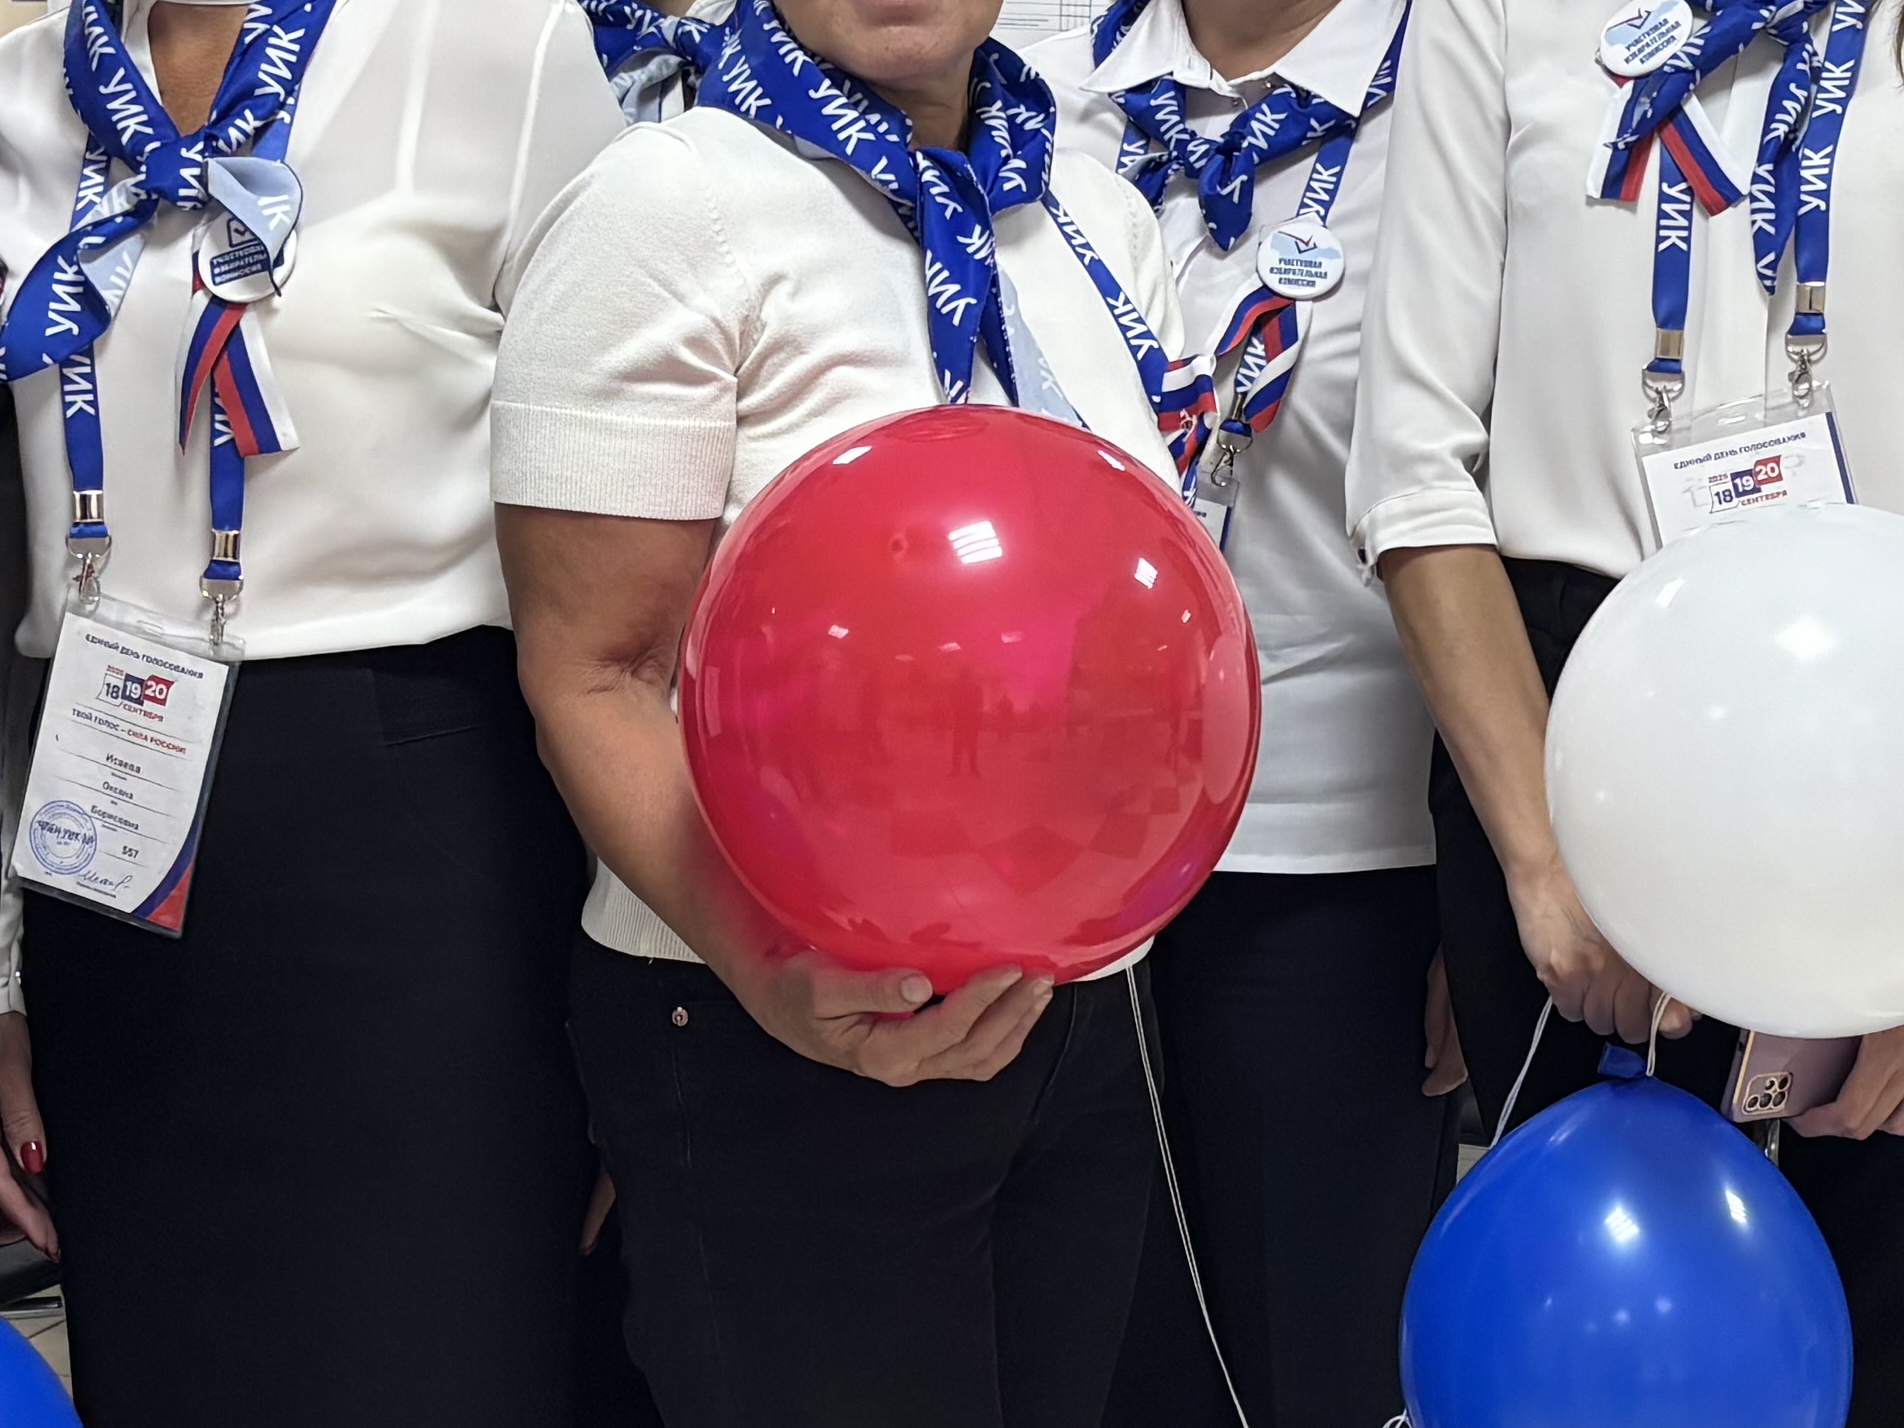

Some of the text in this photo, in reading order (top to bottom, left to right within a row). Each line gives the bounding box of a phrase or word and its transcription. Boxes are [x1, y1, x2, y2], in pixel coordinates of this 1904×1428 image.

[254, 24, 306, 102] УИК
[722, 55, 772, 119] УИК
[1811, 59, 1856, 118] УИК
[98, 66, 154, 146] УИК
[808, 77, 877, 156] УИК
[75, 146, 107, 211] УИК
[1300, 162, 1342, 217] УИК
[1797, 144, 1834, 216] УИК
[1049, 203, 1099, 267] УИК
[1657, 182, 1692, 253] УИК
[45, 255, 86, 336] УИК
[1107, 290, 1160, 361] УИК
[1713, 490, 1733, 506] 18
[1734, 475, 1755, 493] 19
[1755, 462, 1779, 481] 20
[105, 682, 121, 699] 18
[125, 681, 141, 698] 19
[144, 680, 167, 699] 20
